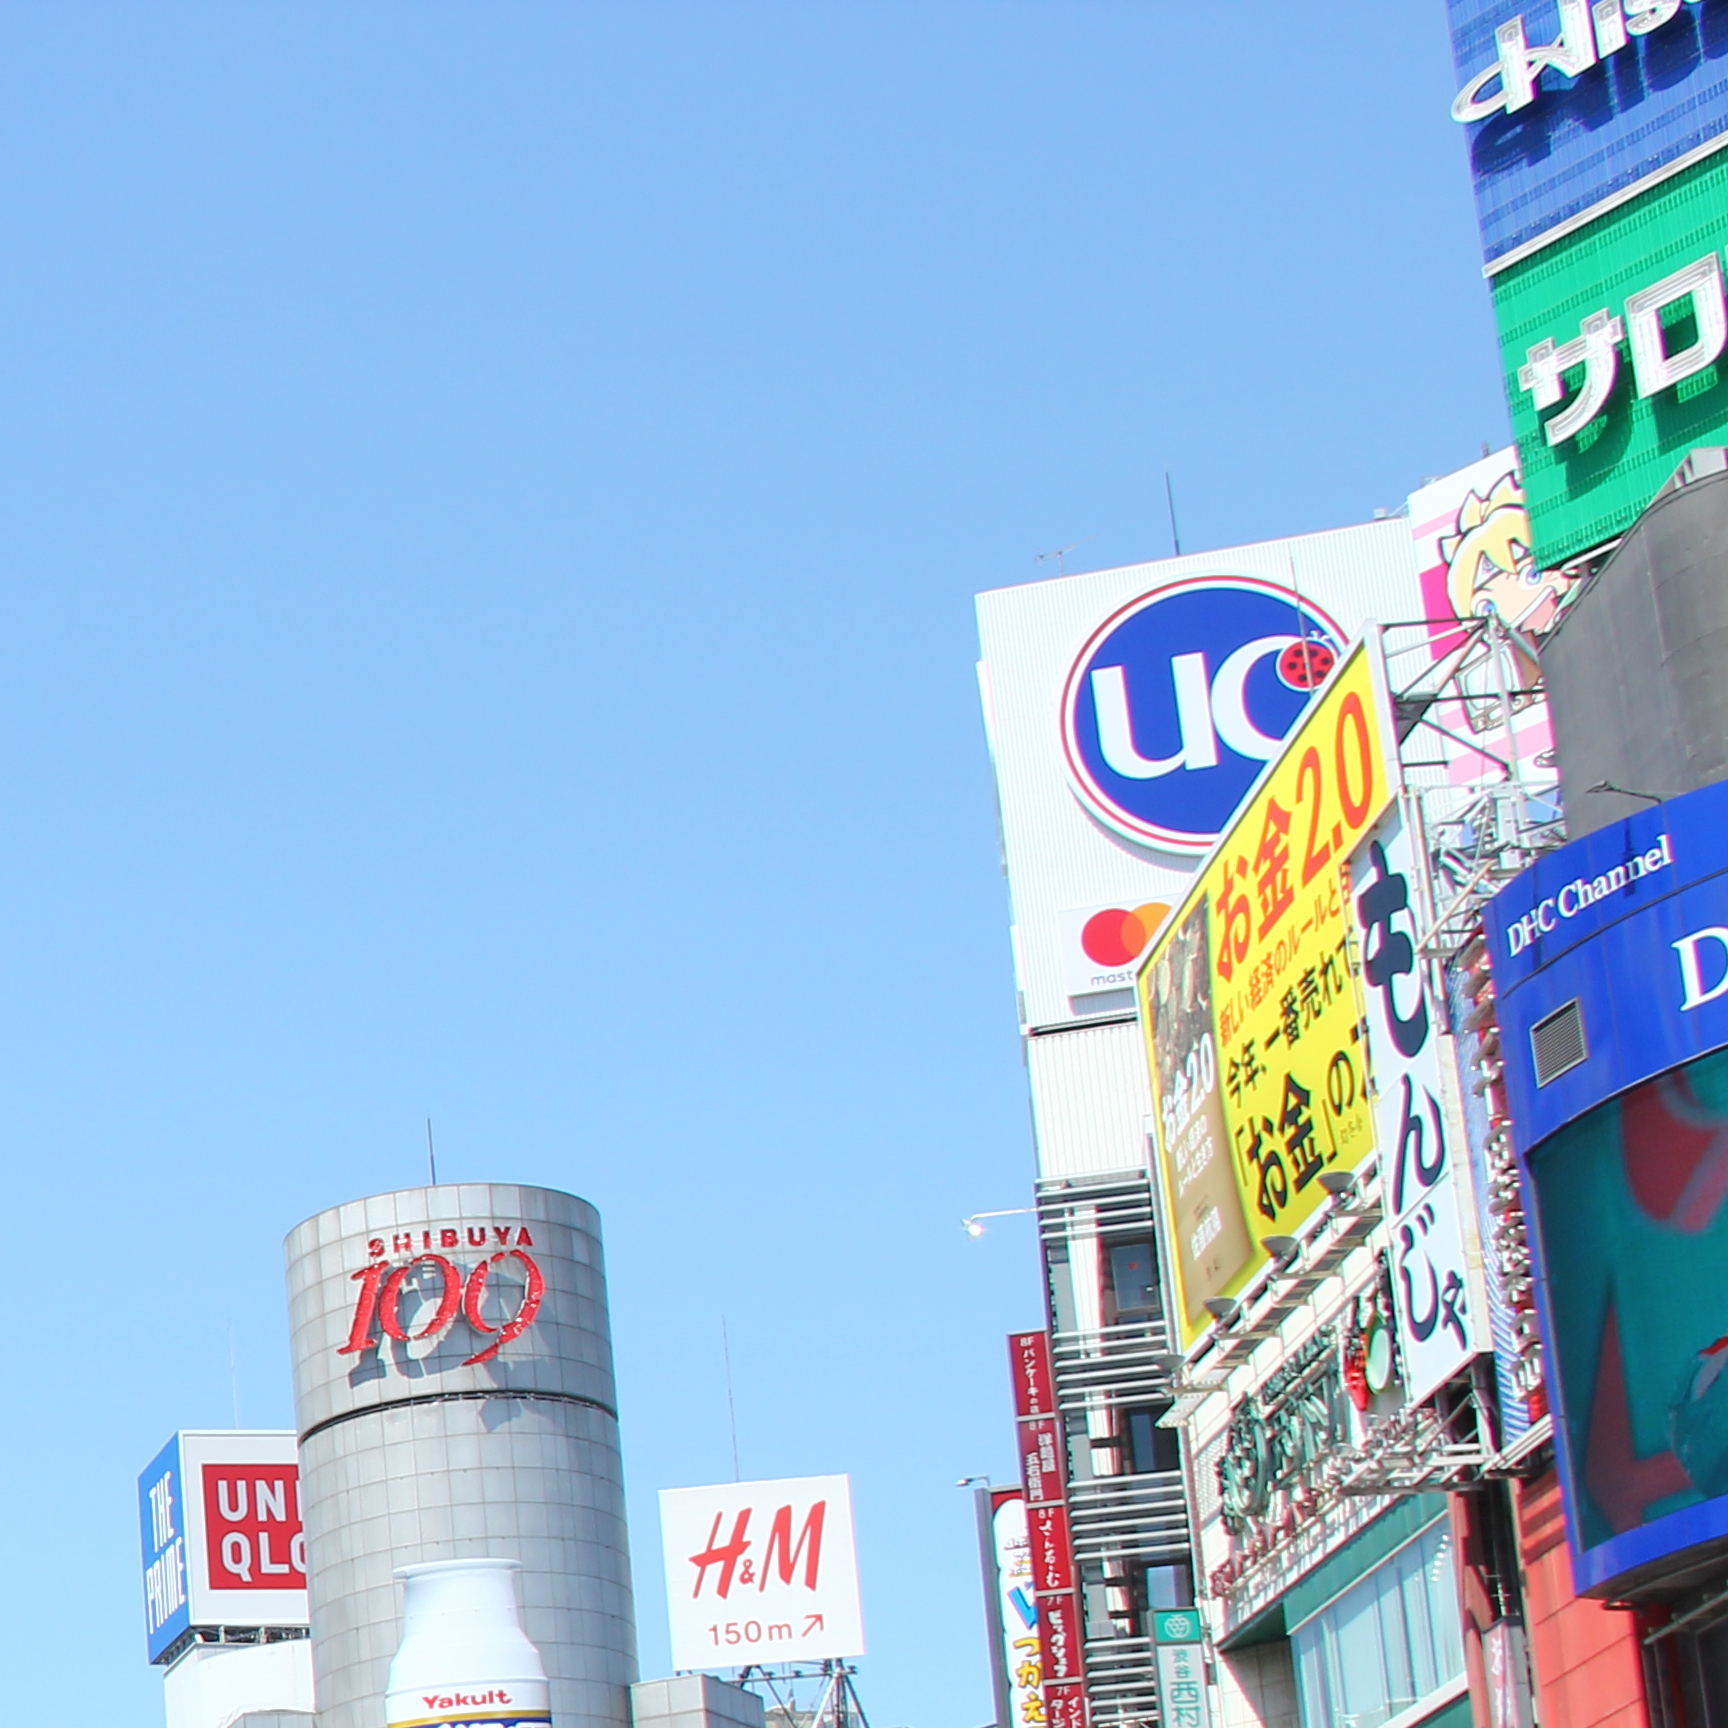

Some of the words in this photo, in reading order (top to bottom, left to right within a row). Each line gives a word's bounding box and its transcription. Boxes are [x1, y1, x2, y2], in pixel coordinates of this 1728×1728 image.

[1215, 690, 1375, 982] お金2.0
[1506, 894, 1557, 957] DHC
[1557, 835, 1673, 920] Channel
[1356, 839, 1468, 1352] もんじゃ
[368, 1226, 535, 1259] SHIBUYA
[336, 1249, 545, 1367] 109
[148, 1469, 175, 1538] THE
[688, 1500, 826, 1601] H&M
[146, 1536, 186, 1636] PRIME
[422, 1688, 513, 1711] Yakult
